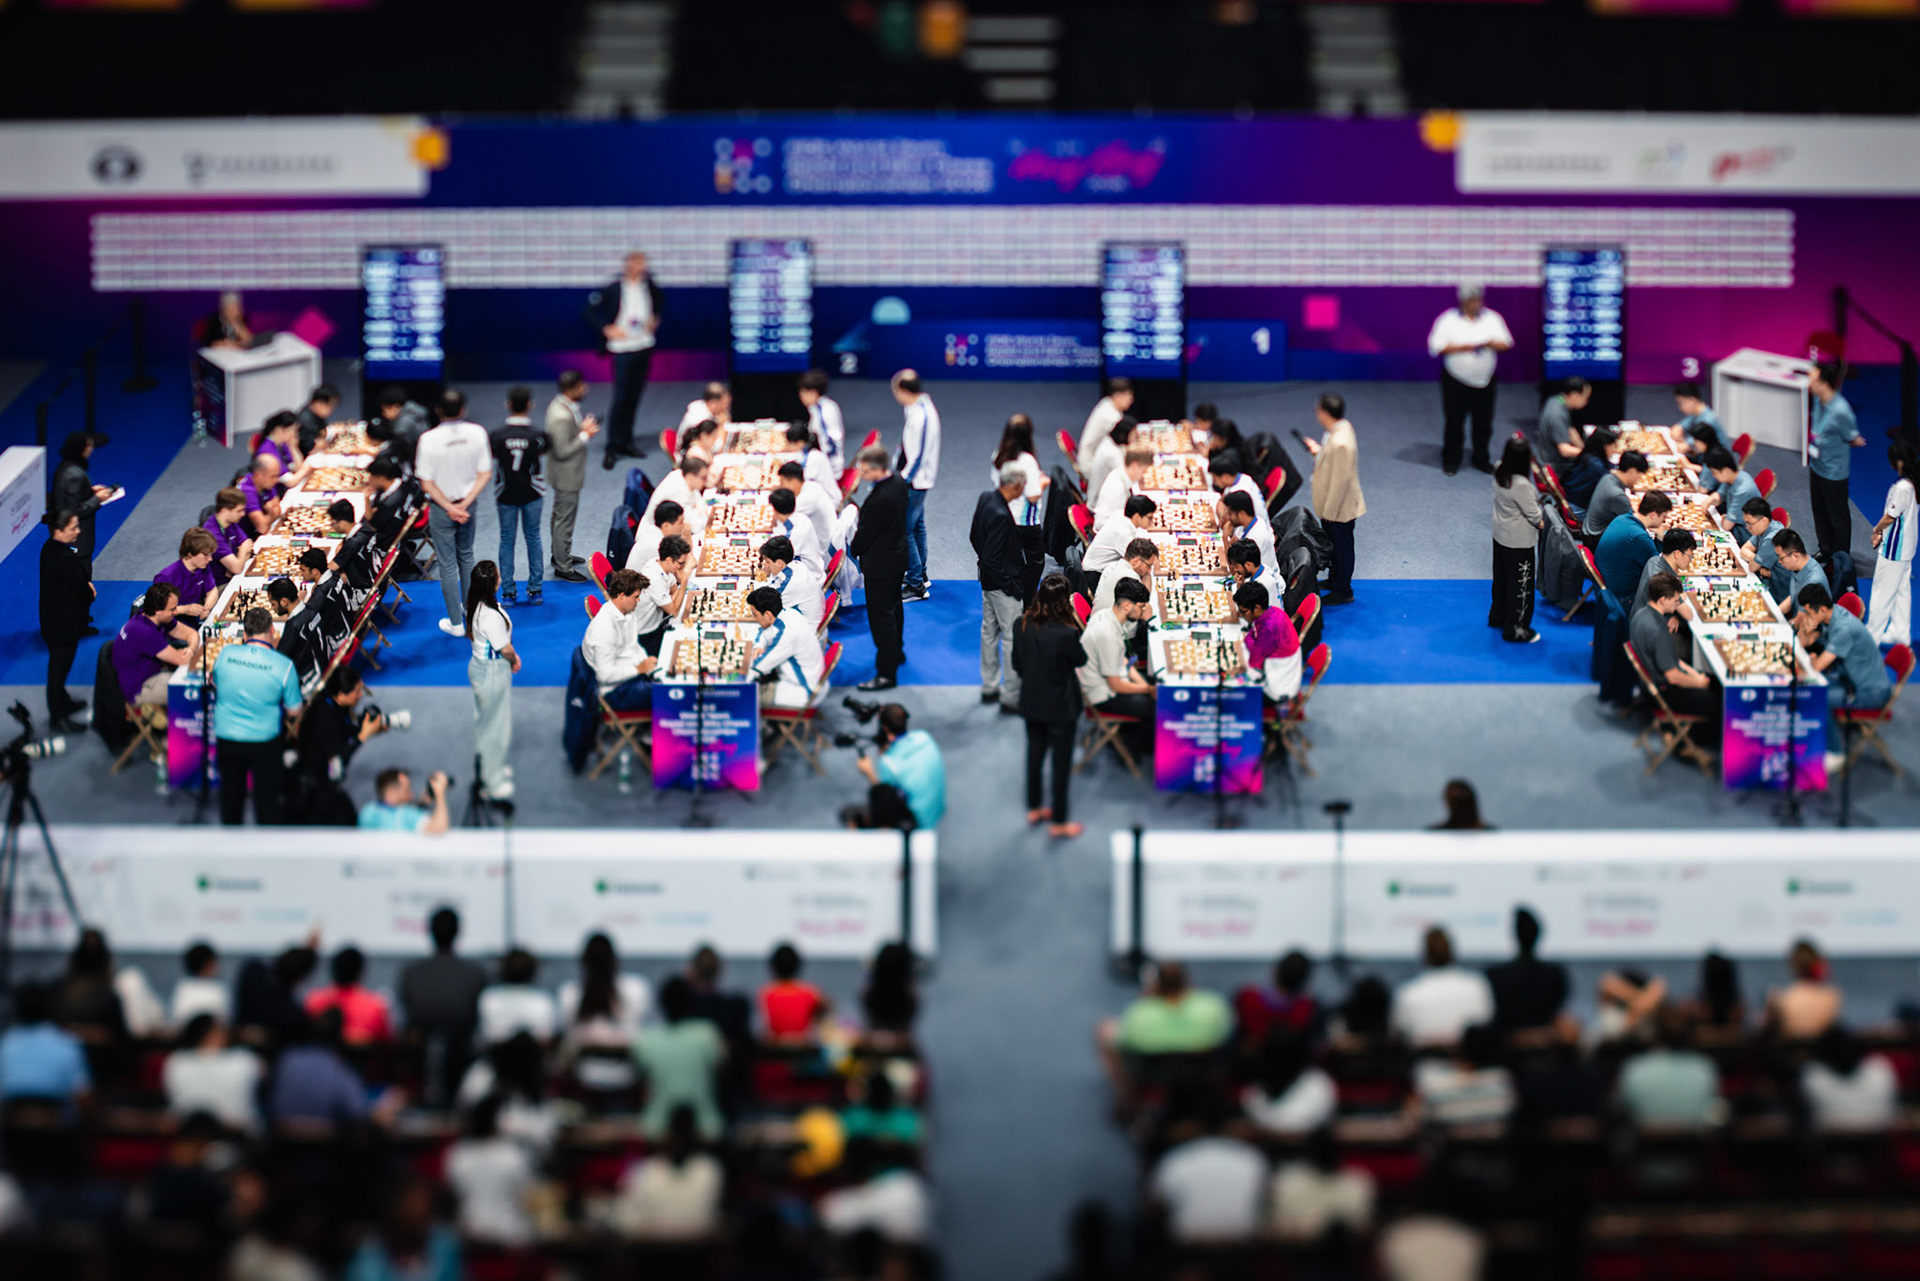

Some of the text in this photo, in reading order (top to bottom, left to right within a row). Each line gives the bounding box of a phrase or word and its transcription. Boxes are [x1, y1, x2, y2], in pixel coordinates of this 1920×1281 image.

[1251, 327, 1270, 355] 1
[840, 352, 858, 374] 2
[1682, 357, 1700, 378] 3
[227, 657, 273, 671] BROADCAST
